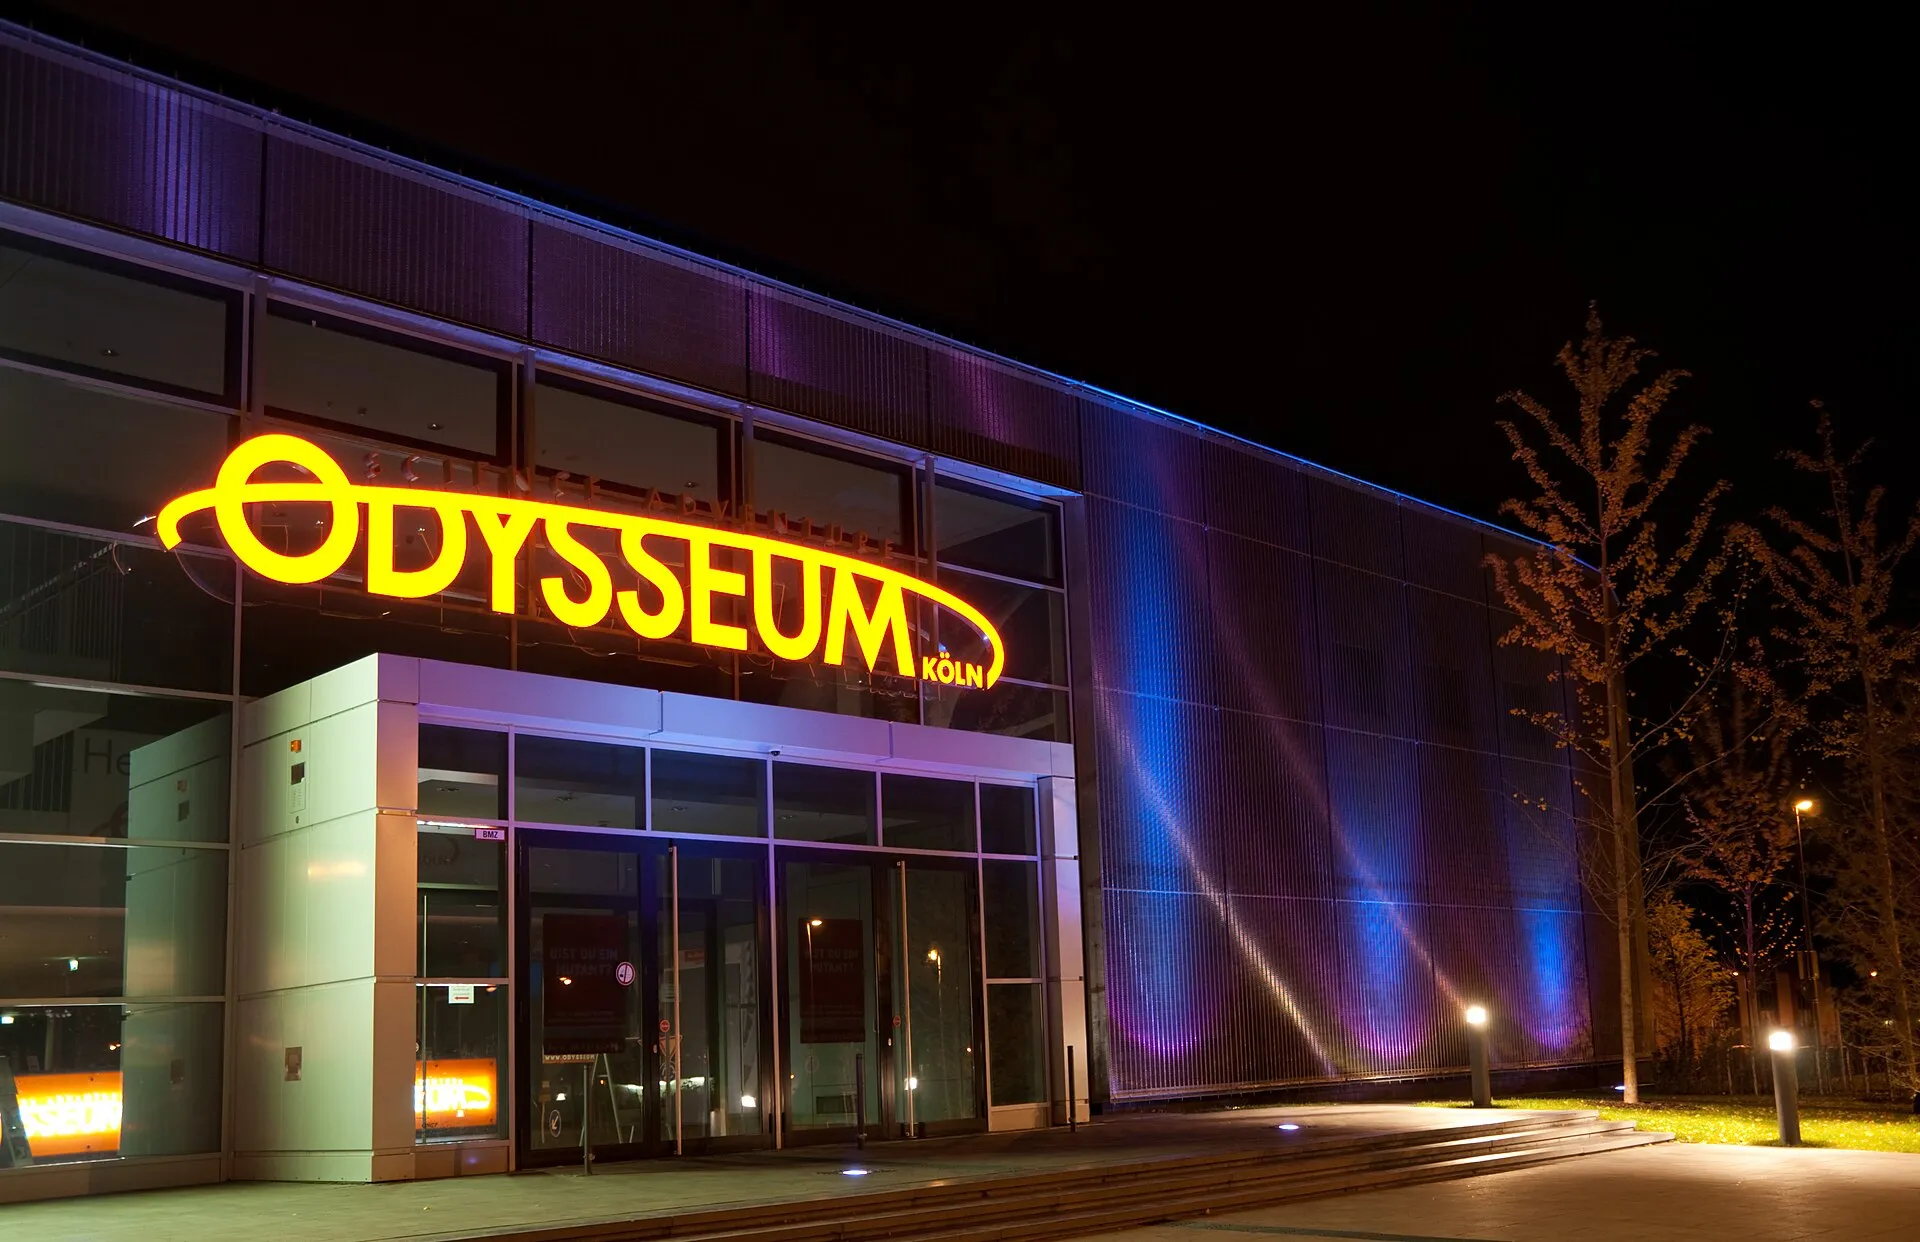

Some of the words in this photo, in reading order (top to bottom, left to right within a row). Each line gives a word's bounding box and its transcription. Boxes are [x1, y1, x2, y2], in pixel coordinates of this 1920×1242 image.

[214, 432, 915, 677] ODYSSEUM
[922, 651, 984, 689] KÖLN
[482, 830, 499, 839] BMZ
